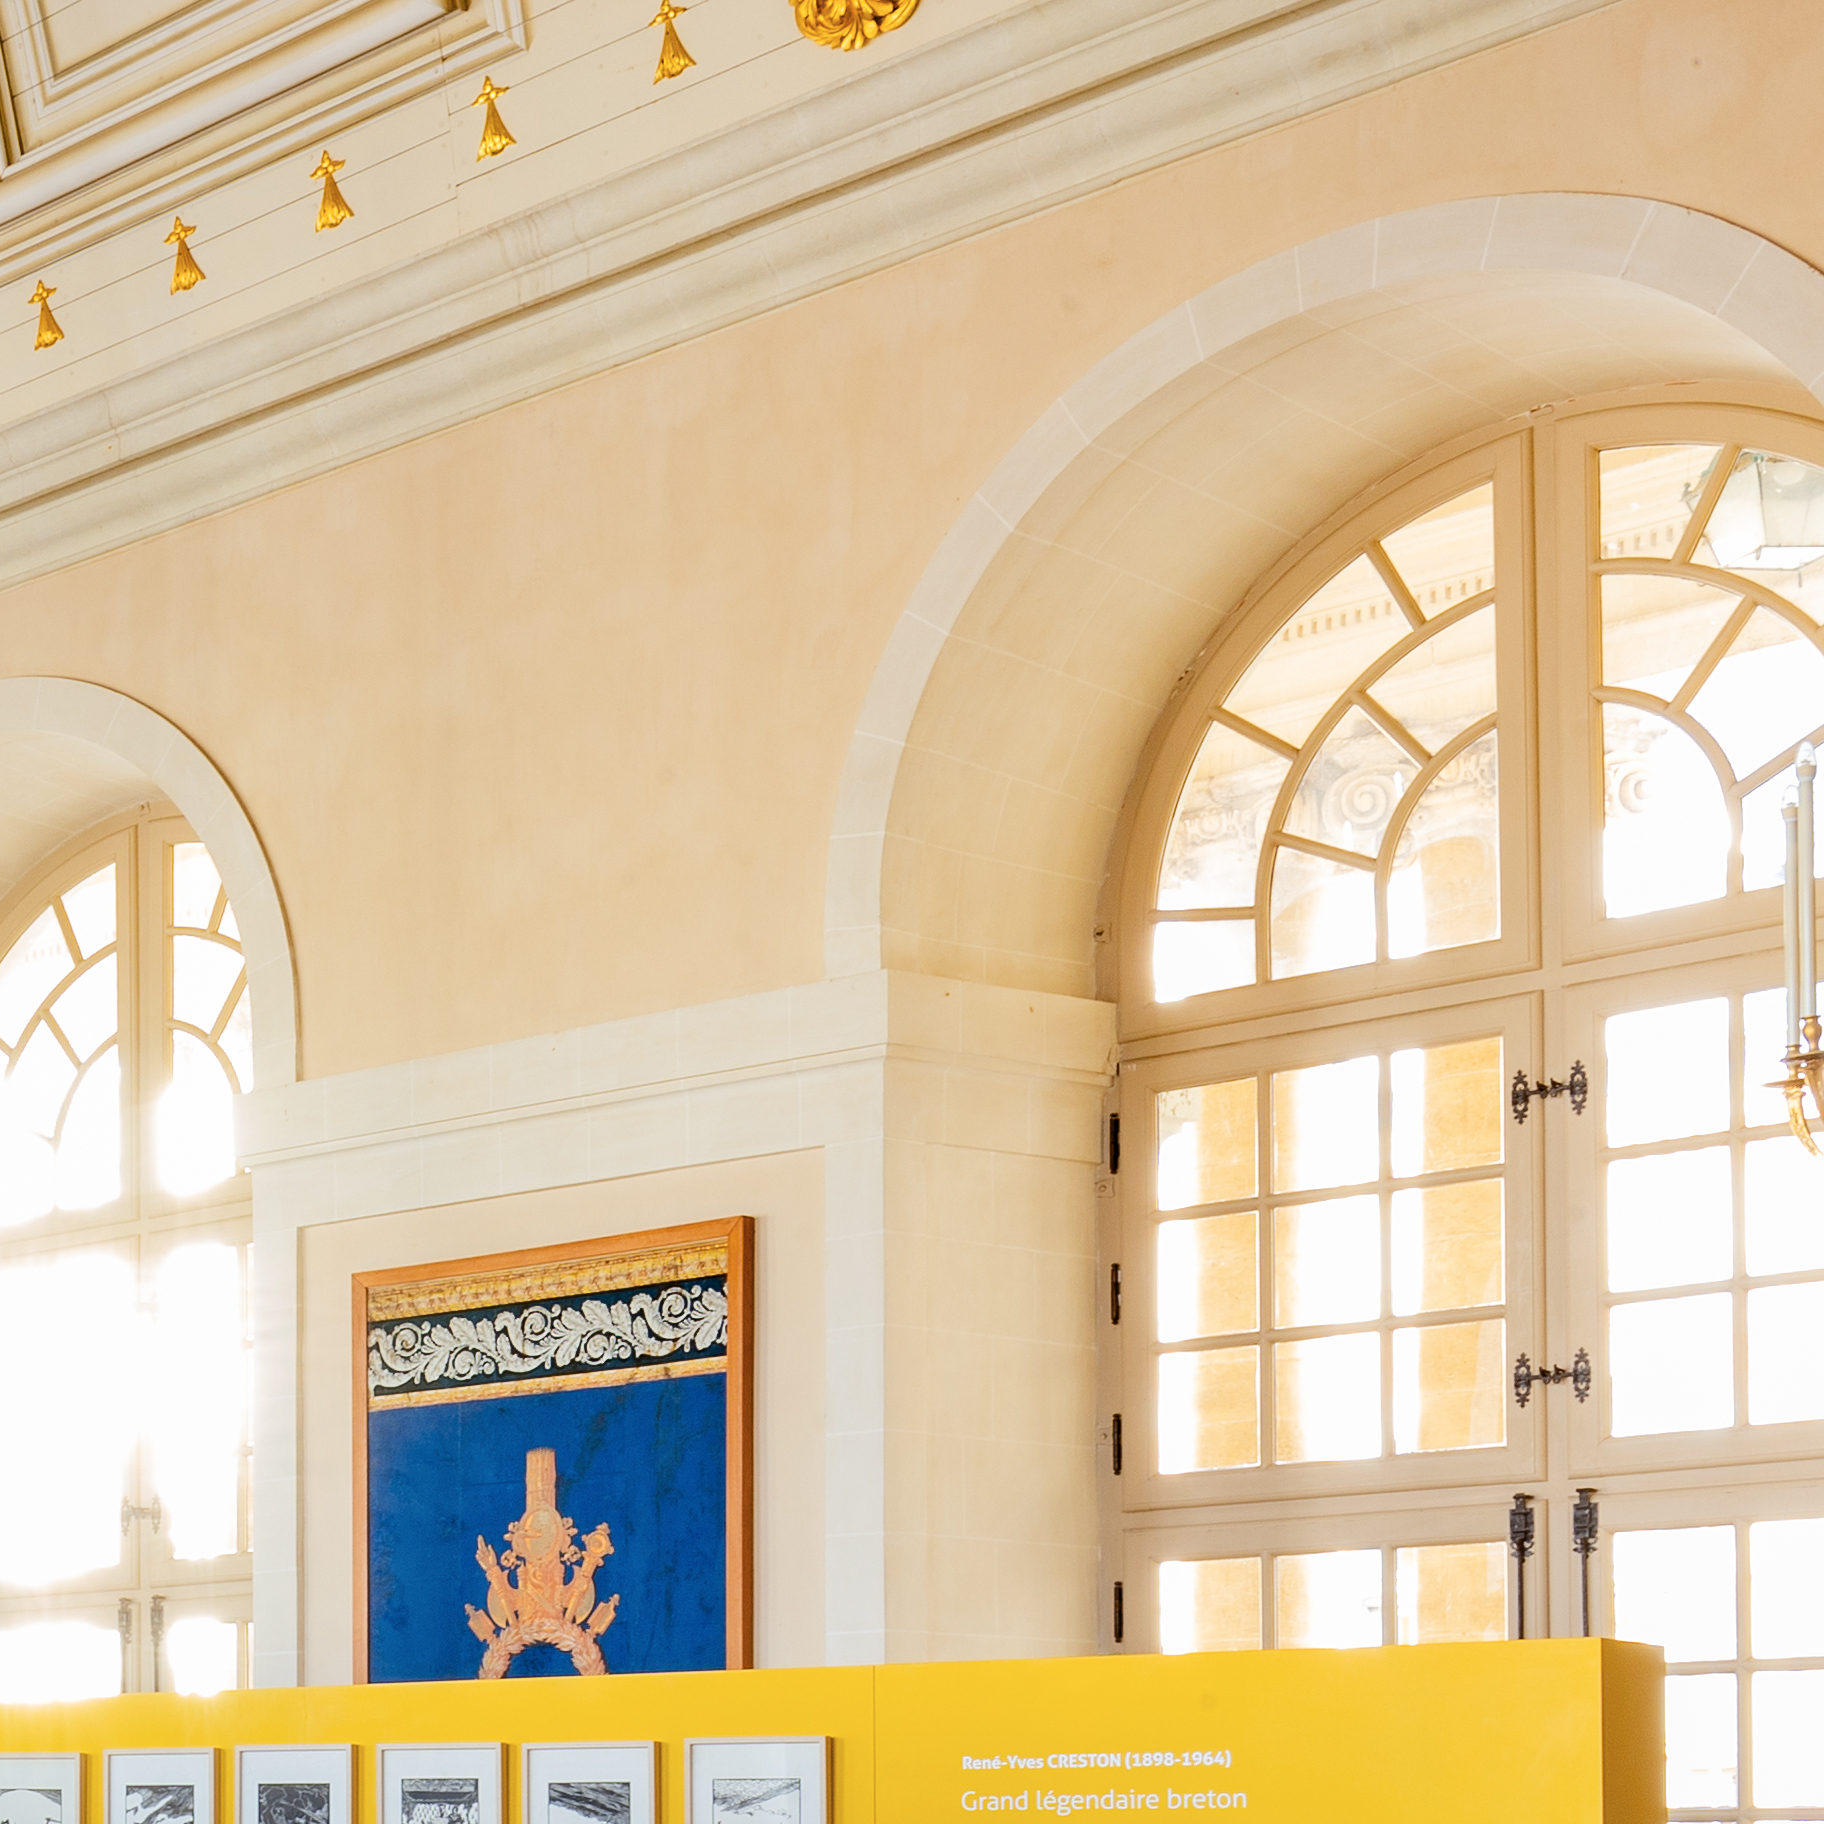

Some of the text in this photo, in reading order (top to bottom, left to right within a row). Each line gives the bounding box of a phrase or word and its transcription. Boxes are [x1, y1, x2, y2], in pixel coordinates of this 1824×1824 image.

[962, 1749, 1232, 1769] René-Yves CRESTON (1898-1964)
[961, 1787, 1247, 1815] Grand légendaire breton
